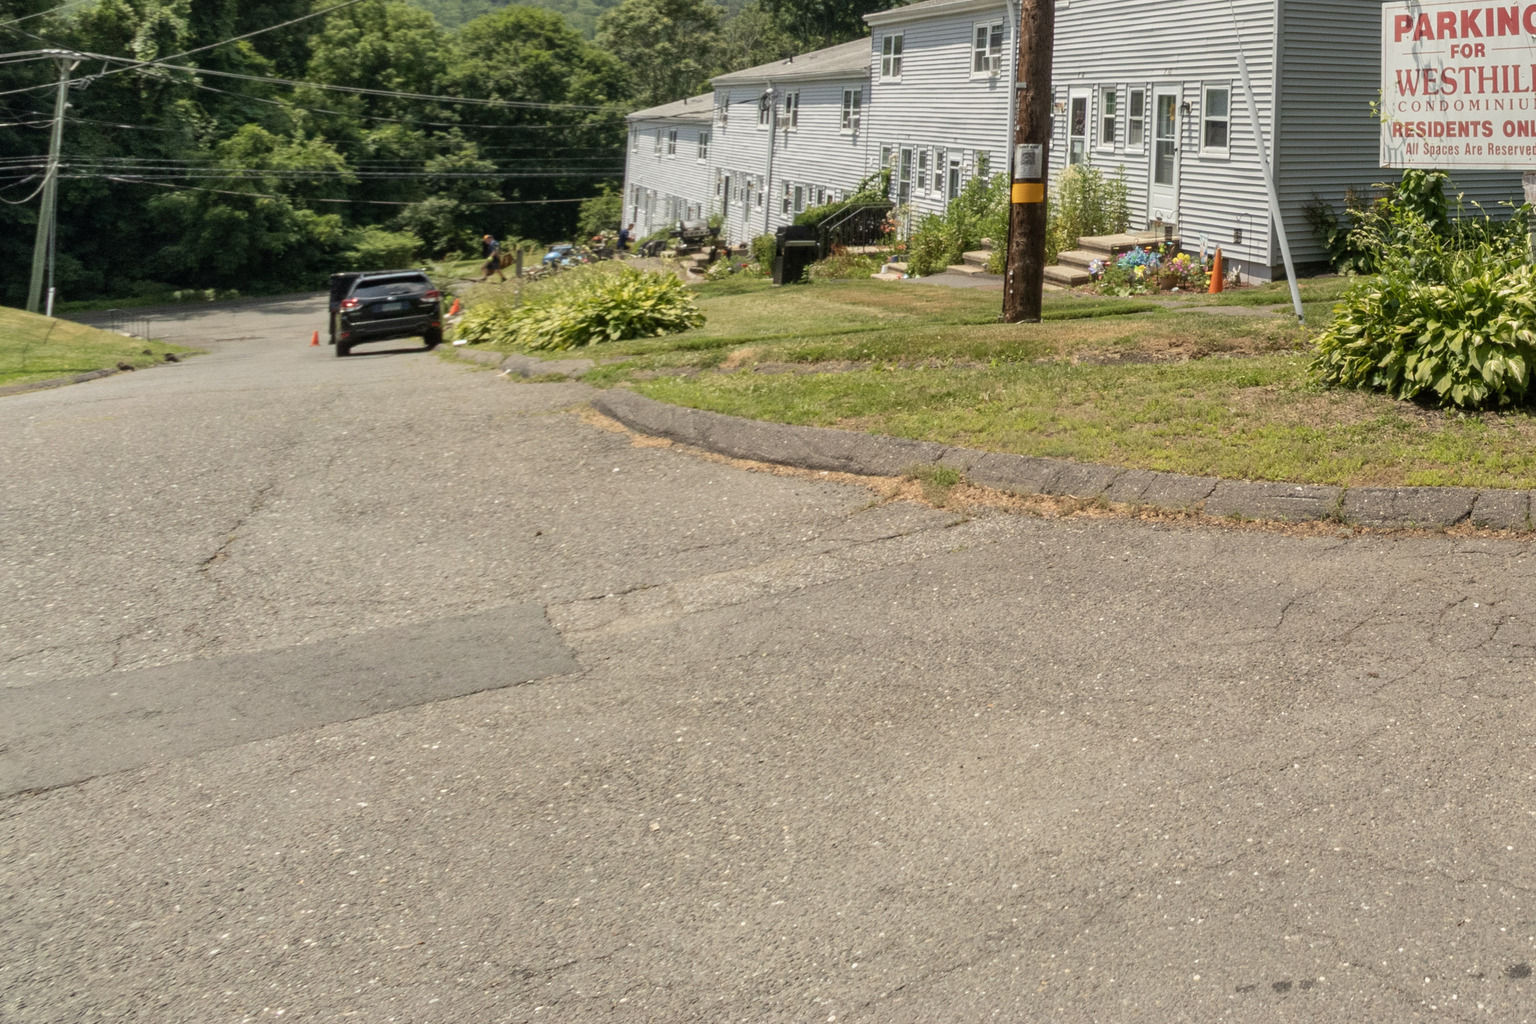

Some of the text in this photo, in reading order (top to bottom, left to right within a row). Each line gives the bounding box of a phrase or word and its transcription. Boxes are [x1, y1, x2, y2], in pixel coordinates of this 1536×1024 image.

[1450, 43, 1486, 58] FOR
[1392, 121, 1493, 138] RESIDENTS
[1405, 143, 1418, 155] All
[1423, 143, 1460, 156] Spaces
[1464, 143, 1483, 156] Are
